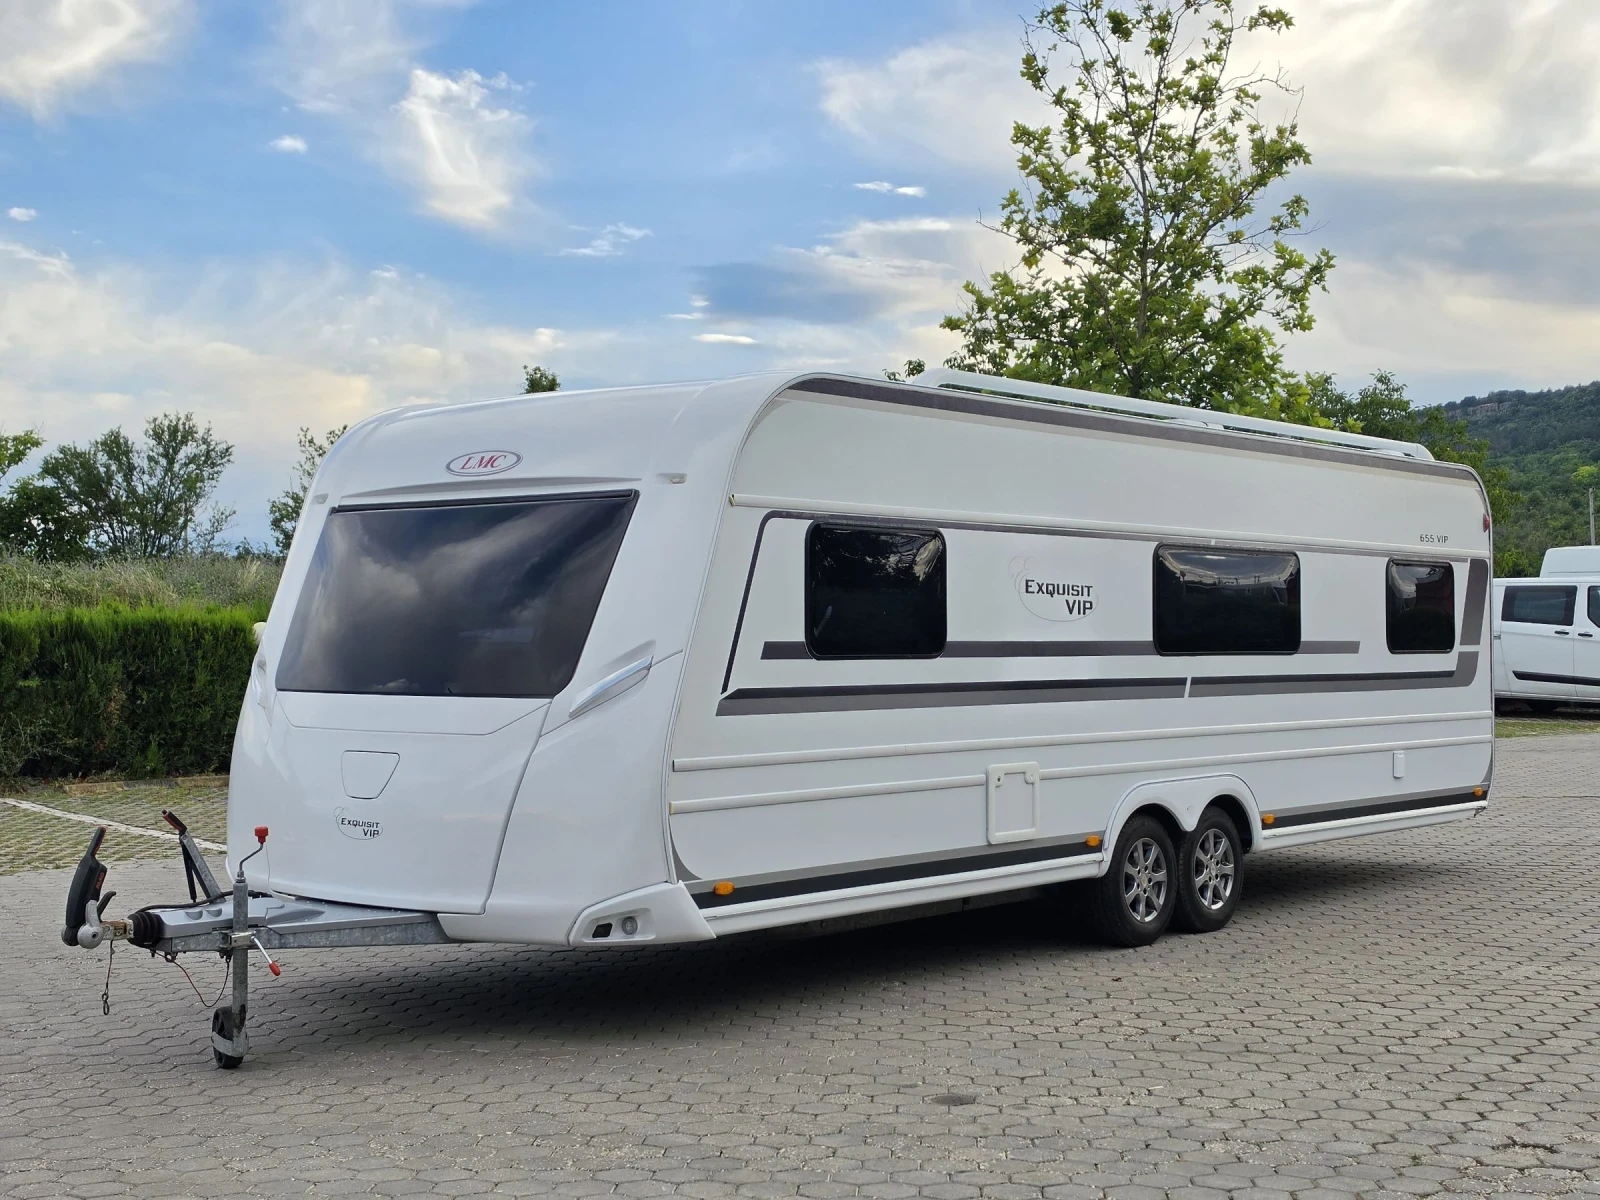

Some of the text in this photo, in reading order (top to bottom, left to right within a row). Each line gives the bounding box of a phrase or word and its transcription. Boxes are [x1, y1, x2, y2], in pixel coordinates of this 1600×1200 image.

[460, 454, 508, 470] LMC
[1420, 533, 1449, 544] 655 VIP
[1025, 579, 1094, 598] EXQUISIT
[1065, 599, 1094, 616] VIP
[341, 817, 380, 829] EXQUISIT
[362, 828, 380, 838] VIP
